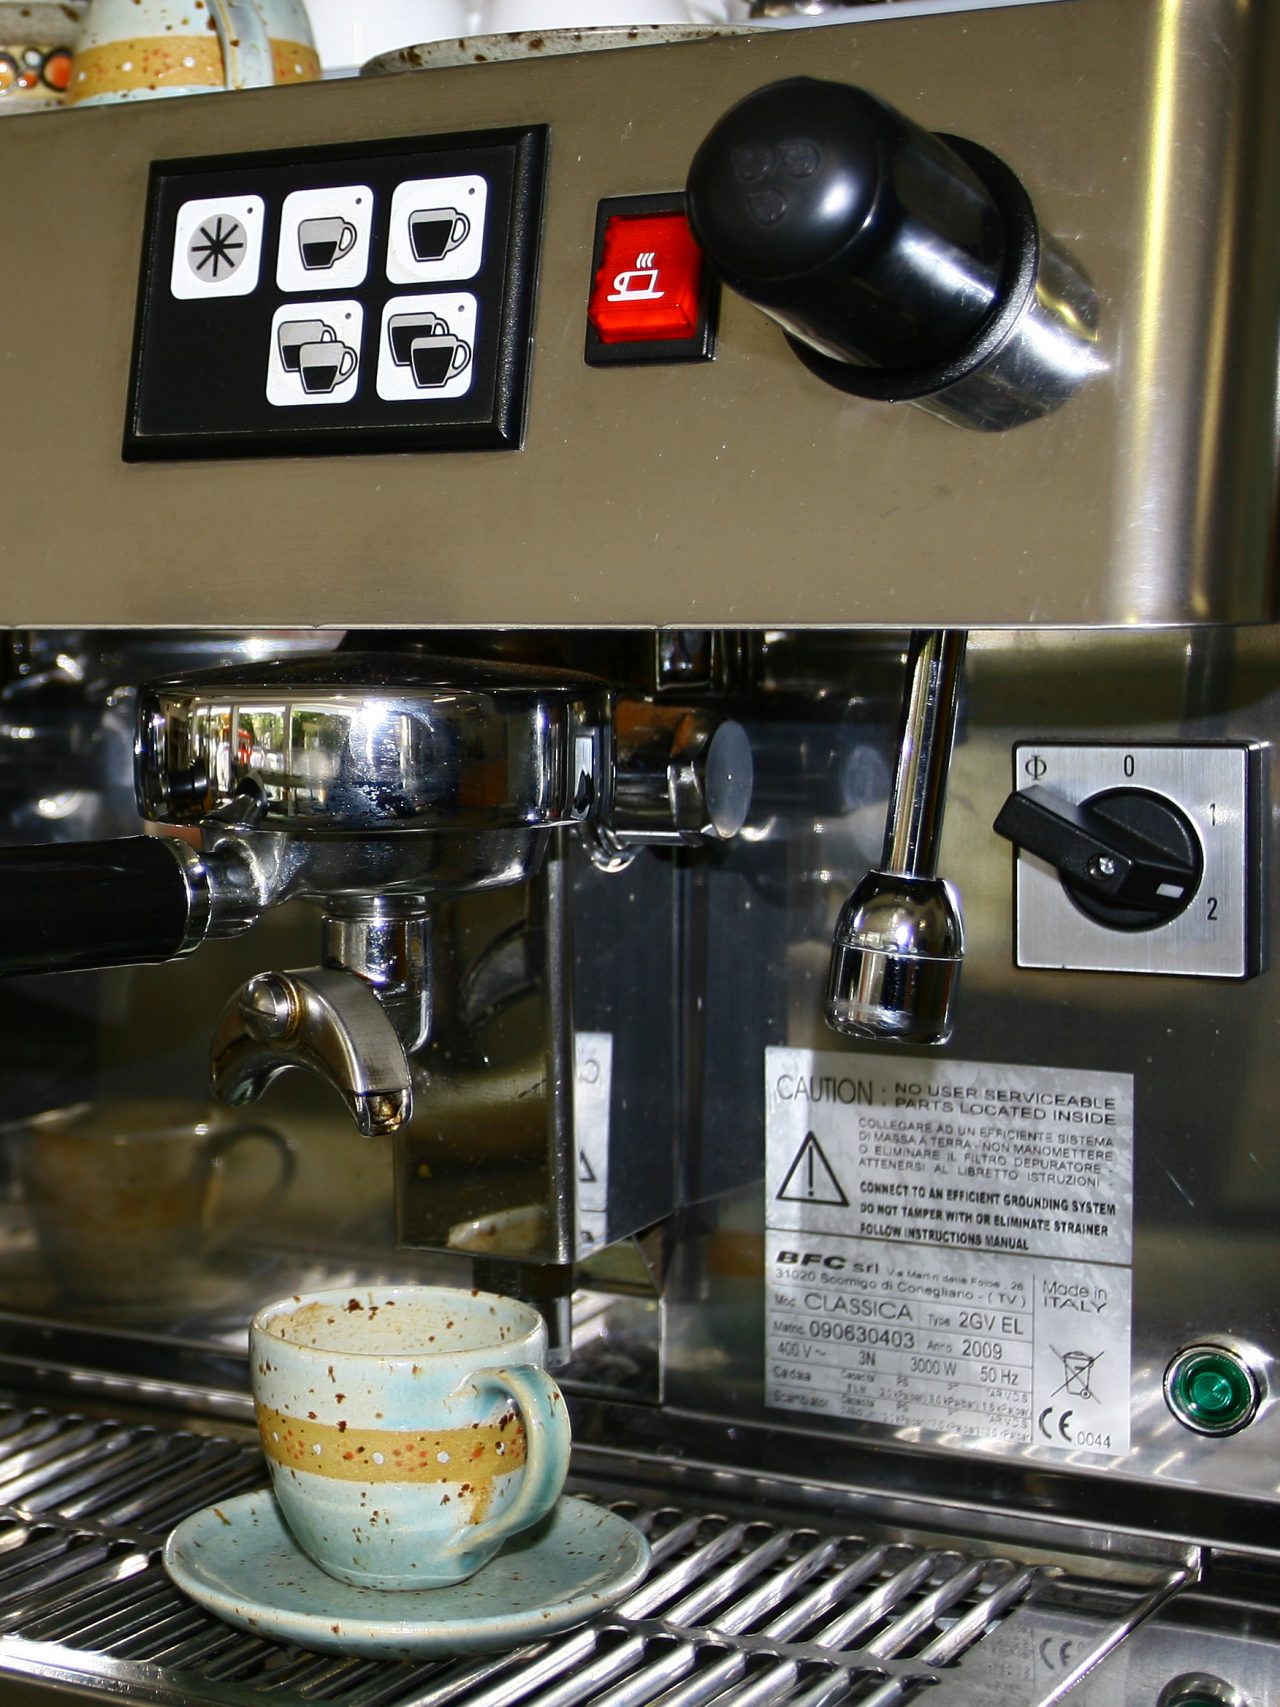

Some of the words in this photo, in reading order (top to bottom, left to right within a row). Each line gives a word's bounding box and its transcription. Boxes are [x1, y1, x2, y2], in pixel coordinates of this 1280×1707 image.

[1123, 754, 1135, 777] 0
[1209, 803, 1216, 827] 1
[1207, 897, 1217, 921] 2
[776, 1074, 873, 1105] CAUTION
[895, 1082, 921, 1096] NO
[928, 1084, 977, 1099] USER
[984, 1090, 1116, 1111] SERVICEABLE
[895, 1097, 954, 1113] PARTS
[960, 1102, 1046, 1121] LOCATED
[1053, 1110, 1117, 1126] INSIDE
[858, 1117, 931, 1132] COLLEGARE
[936, 1124, 953, 1135] AD
[958, 1126, 975, 1137] UN
[980, 1128, 1053, 1143] EFFICIENTE
[1058, 1133, 1114, 1148] SISTEMA
[859, 1132, 870, 1142] DI
[875, 1133, 915, 1146] MASSA
[919, 1136, 927, 1147] A
[930, 1137, 974, 1149] TERRA
[982, 1142, 1010, 1153] NON
[1013, 1144, 1113, 1162] MANOMETTERE
[859, 1145, 868, 1155] O
[875, 1146, 940, 1161] ELIMINARE
[947, 1151, 956, 1162] IL
[964, 1153, 1007, 1167] FILTRO
[1013, 1158, 1102, 1175] DEPURATORE
[858, 1158, 925, 1172] ATTENERSI
[934, 1165, 948, 1175] AL
[958, 1167, 1019, 1181] LIBRETTO
[1027, 1174, 1100, 1189] ISTRUZIONI
[860, 1181, 909, 1197] CONNECT
[912, 1185, 926, 1199] TO
[928, 1188, 943, 1200] AN
[946, 1188, 1000, 1205] EFFICIENT
[1003, 1194, 1069, 1212] GROUNDING
[1072, 1200, 1116, 1216] SYSTEM
[860, 1202, 874, 1214] DO
[877, 1204, 898, 1216] NOT
[902, 1206, 943, 1221] TAMPER
[945, 1210, 973, 1224] WITH
[976, 1213, 990, 1226] OR
[994, 1215, 1051, 1231] ELIMINATE
[1054, 1220, 1109, 1237] STRAINER
[860, 1222, 902, 1238] FOLLOW
[904, 1228, 982, 1246] INSTRUCTIONS
[985, 1235, 1029, 1251] MANUAL
[776, 1251, 847, 1270] BFC
[852, 1262, 879, 1275] srl
[776, 1268, 816, 1282] 31020
[820, 1273, 877, 1290] Scomigo
[881, 1280, 893, 1291] di
[896, 1281, 974, 1299] Conegliano
[1042, 1279, 1090, 1298] Made
[1094, 1286, 1107, 1300] in
[804, 1292, 913, 1321] CLASSICA
[1043, 1296, 1108, 1314] ITALY
[809, 1320, 915, 1349] 090630403
[958, 1311, 996, 1331] 2GV
[1001, 1316, 1024, 1335] EL
[777, 1341, 800, 1357] 400
[802, 1344, 812, 1359] V
[858, 1350, 876, 1367] 3N
[961, 1338, 1003, 1360] 2009
[910, 1356, 940, 1376] 3000
[943, 1361, 957, 1377] W
[980, 1366, 997, 1383] 50
[1001, 1369, 1019, 1386] Hz
[1077, 1430, 1112, 1450] 0044
